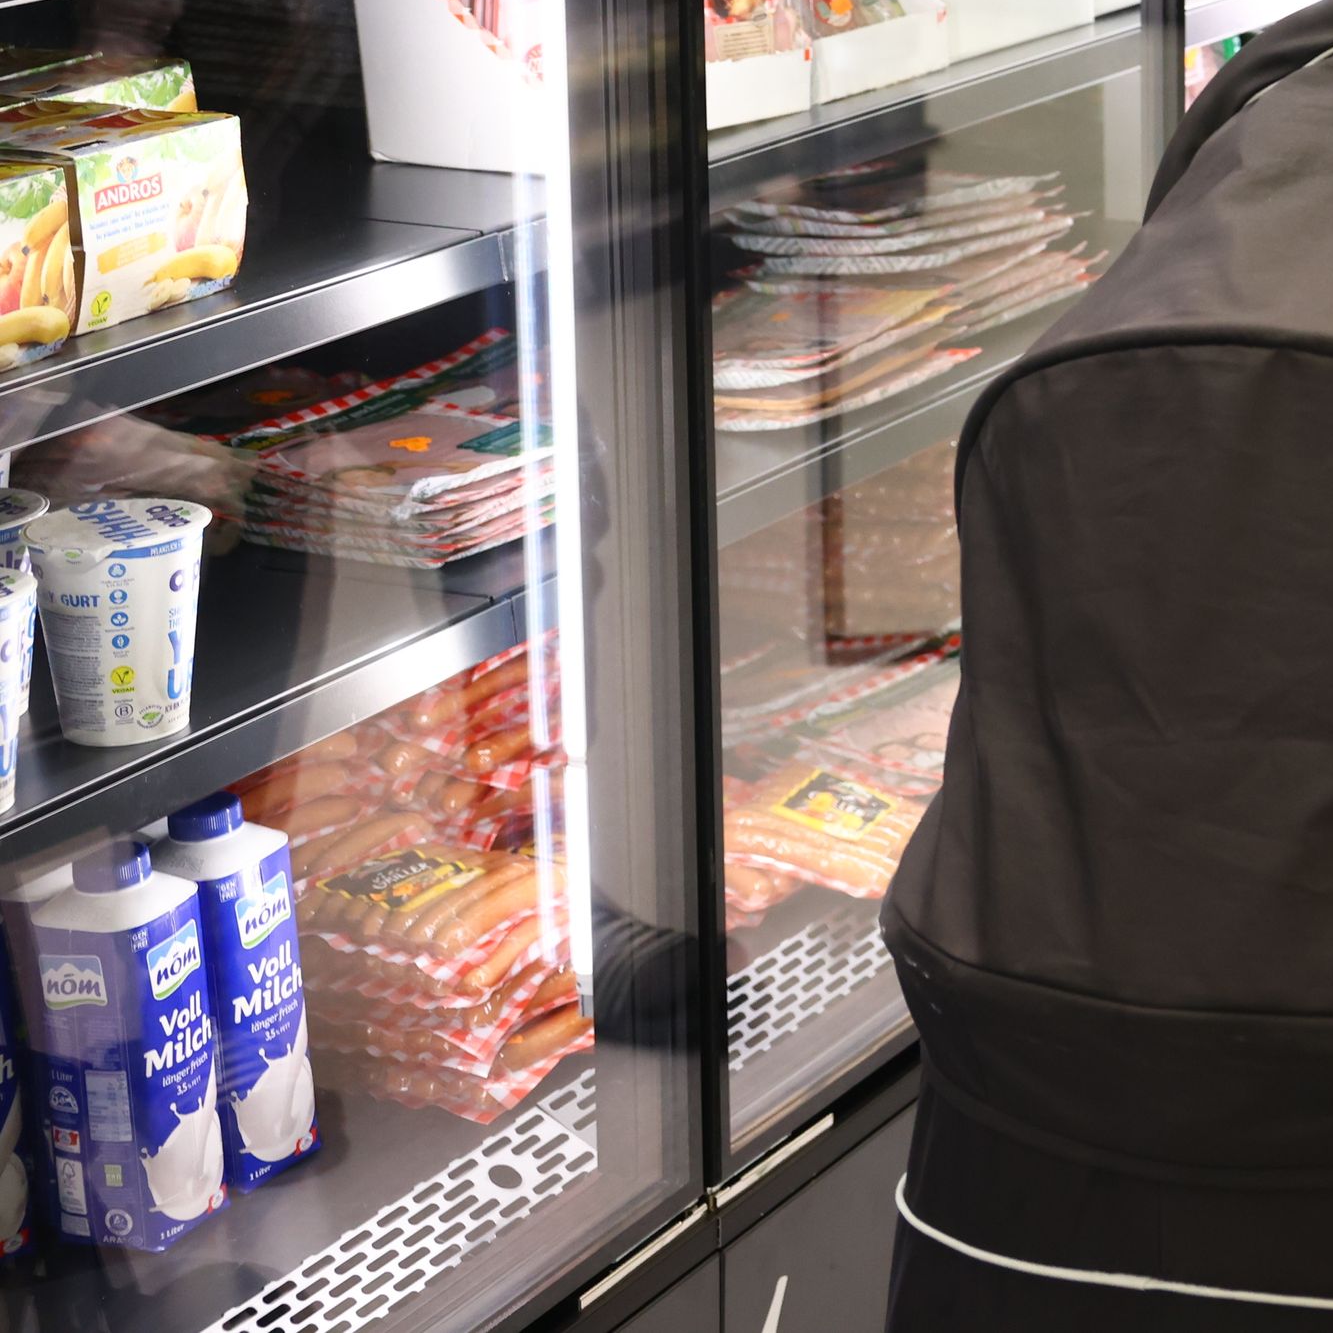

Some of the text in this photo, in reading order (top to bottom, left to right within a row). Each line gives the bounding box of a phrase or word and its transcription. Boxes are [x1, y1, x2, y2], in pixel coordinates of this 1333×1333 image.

[96, 175, 162, 210] ANDROS
[111, 686, 135, 695] VEGAN
[220, 881, 236, 892] GEN
[221, 889, 238, 901] FREI
[132, 930, 148, 942] GEN
[132, 939, 149, 951] FREI
[247, 939, 292, 985] Voll
[232, 962, 303, 1025] Milch
[159, 990, 202, 1037] Voll
[251, 998, 299, 1034] länger frisch
[143, 1013, 213, 1078] Milch
[55, 1069, 74, 1083] Liter
[162, 1050, 208, 1088] länger frisch
[254, 1164, 272, 1180] Liter
[165, 1223, 185, 1238] Liter
